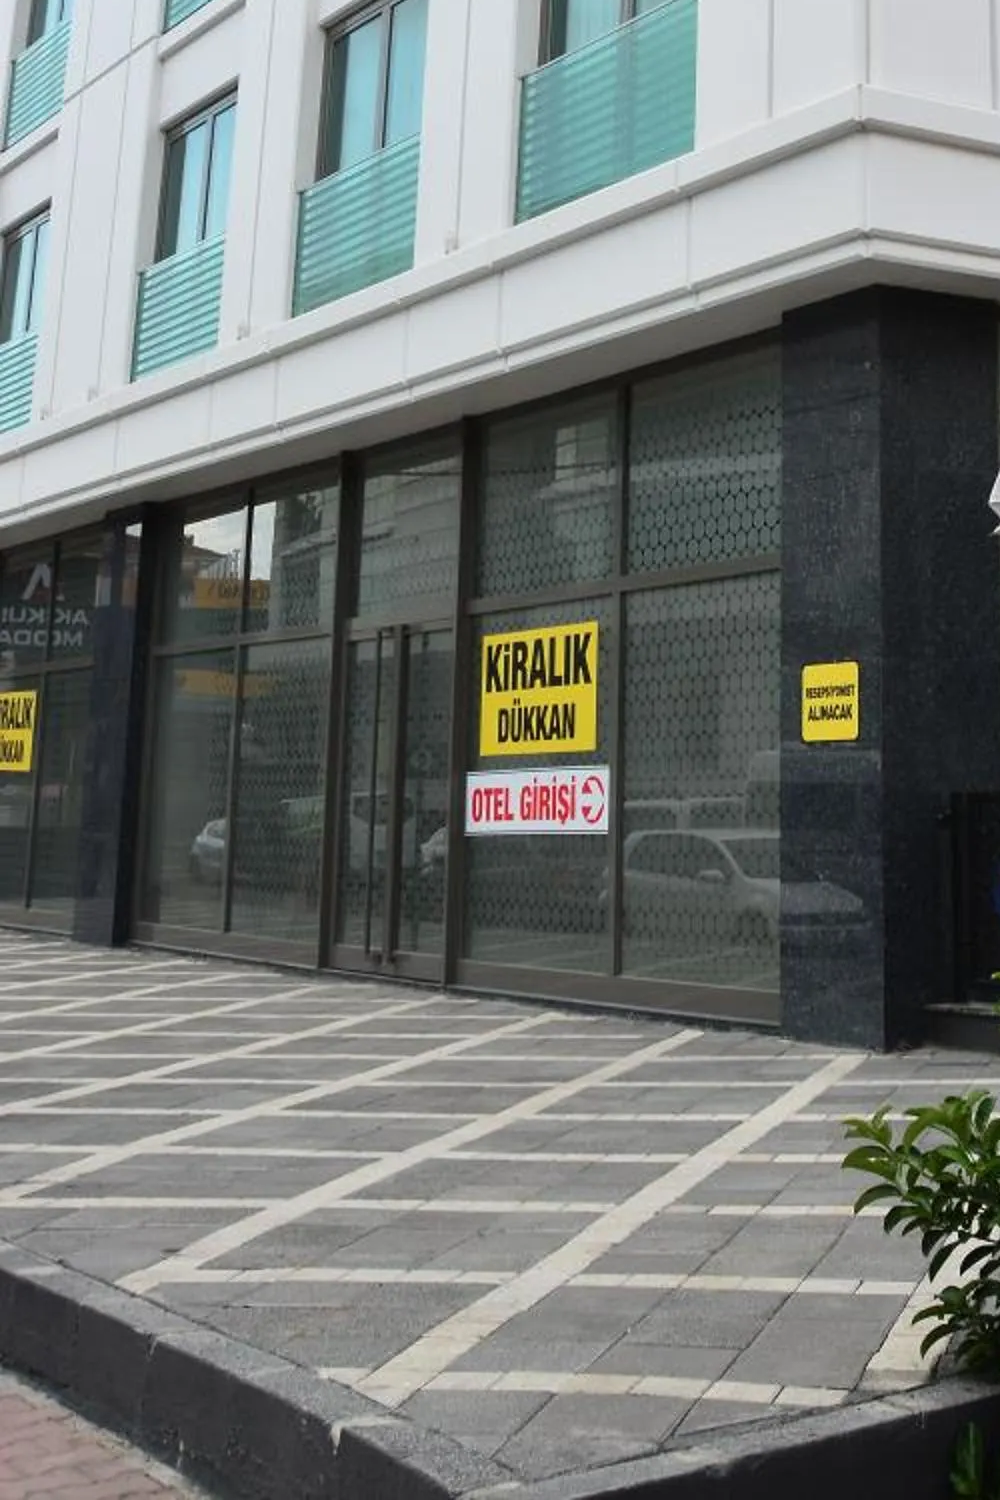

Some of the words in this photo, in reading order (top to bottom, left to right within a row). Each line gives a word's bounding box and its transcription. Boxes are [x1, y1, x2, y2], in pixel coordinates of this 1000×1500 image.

[497, 698, 576, 743] DÜKKAN
[471, 787, 515, 823] OTEL
[519, 775, 577, 825] GİRİŞİ
